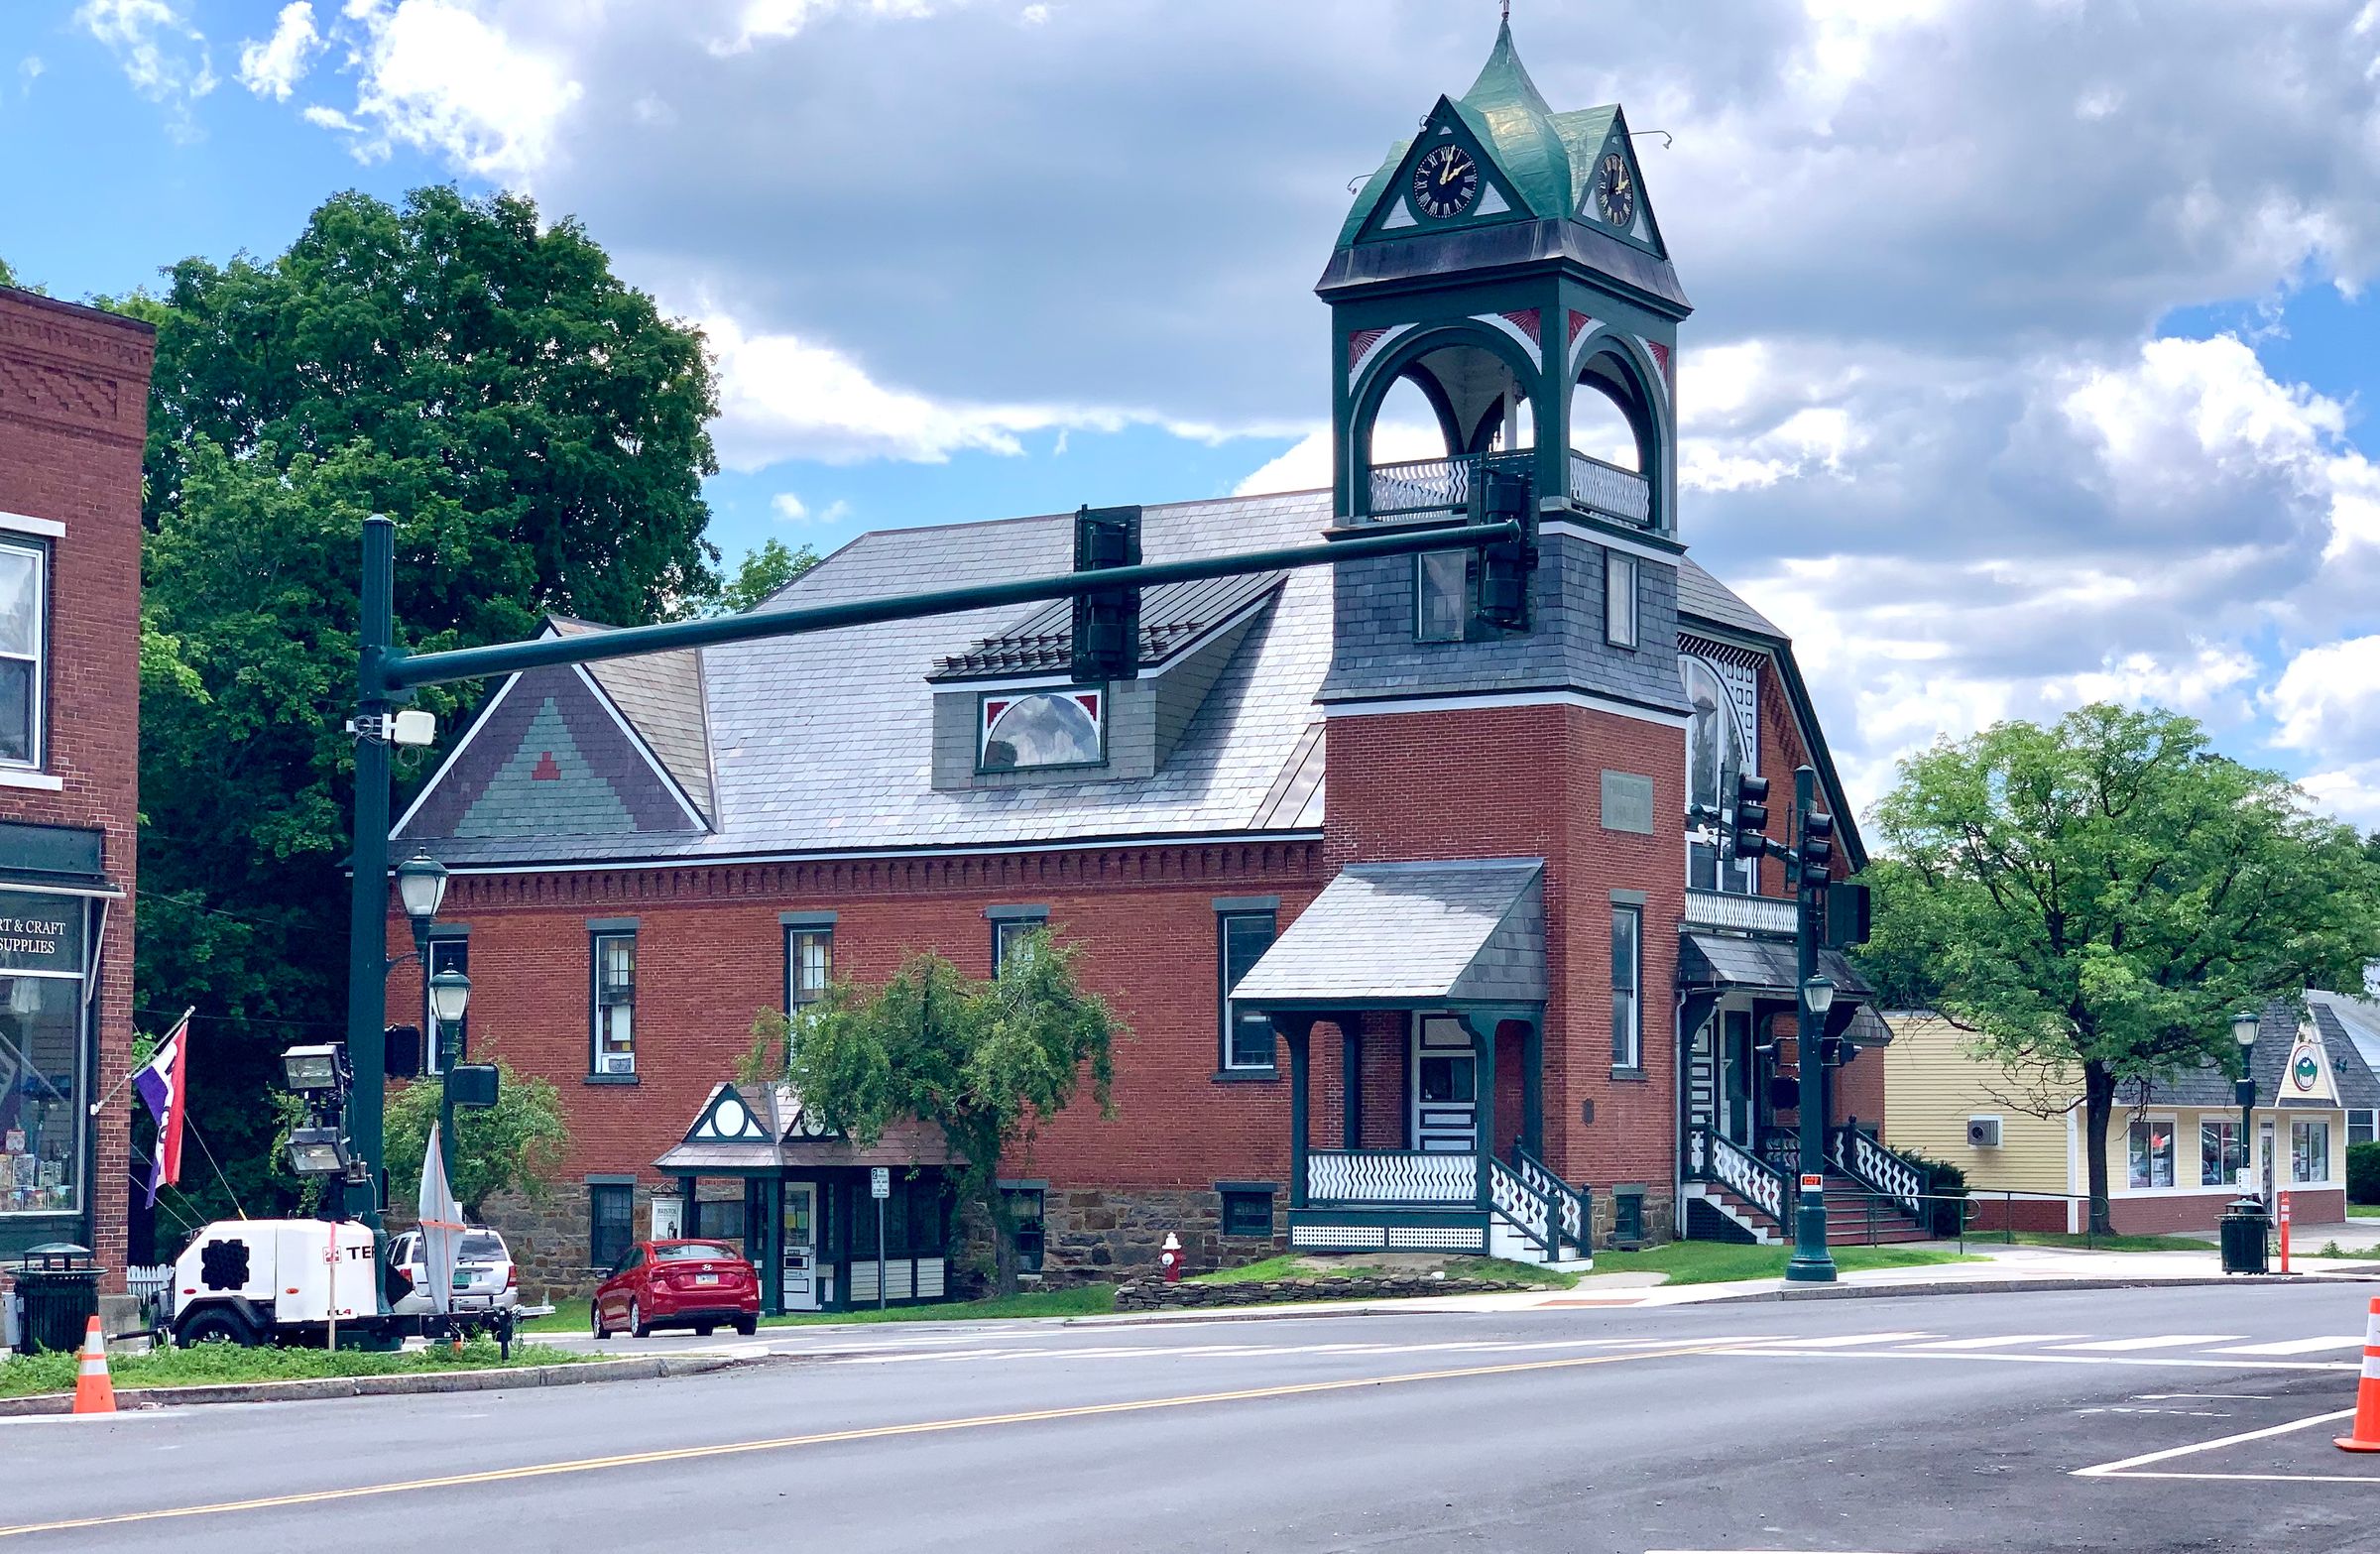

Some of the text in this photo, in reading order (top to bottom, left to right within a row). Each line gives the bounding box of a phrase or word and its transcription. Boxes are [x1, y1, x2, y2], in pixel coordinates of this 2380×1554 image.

[14, 919, 24, 932] &
[26, 920, 66, 935] CRAFT
[327, 1308, 352, 1317] L4
